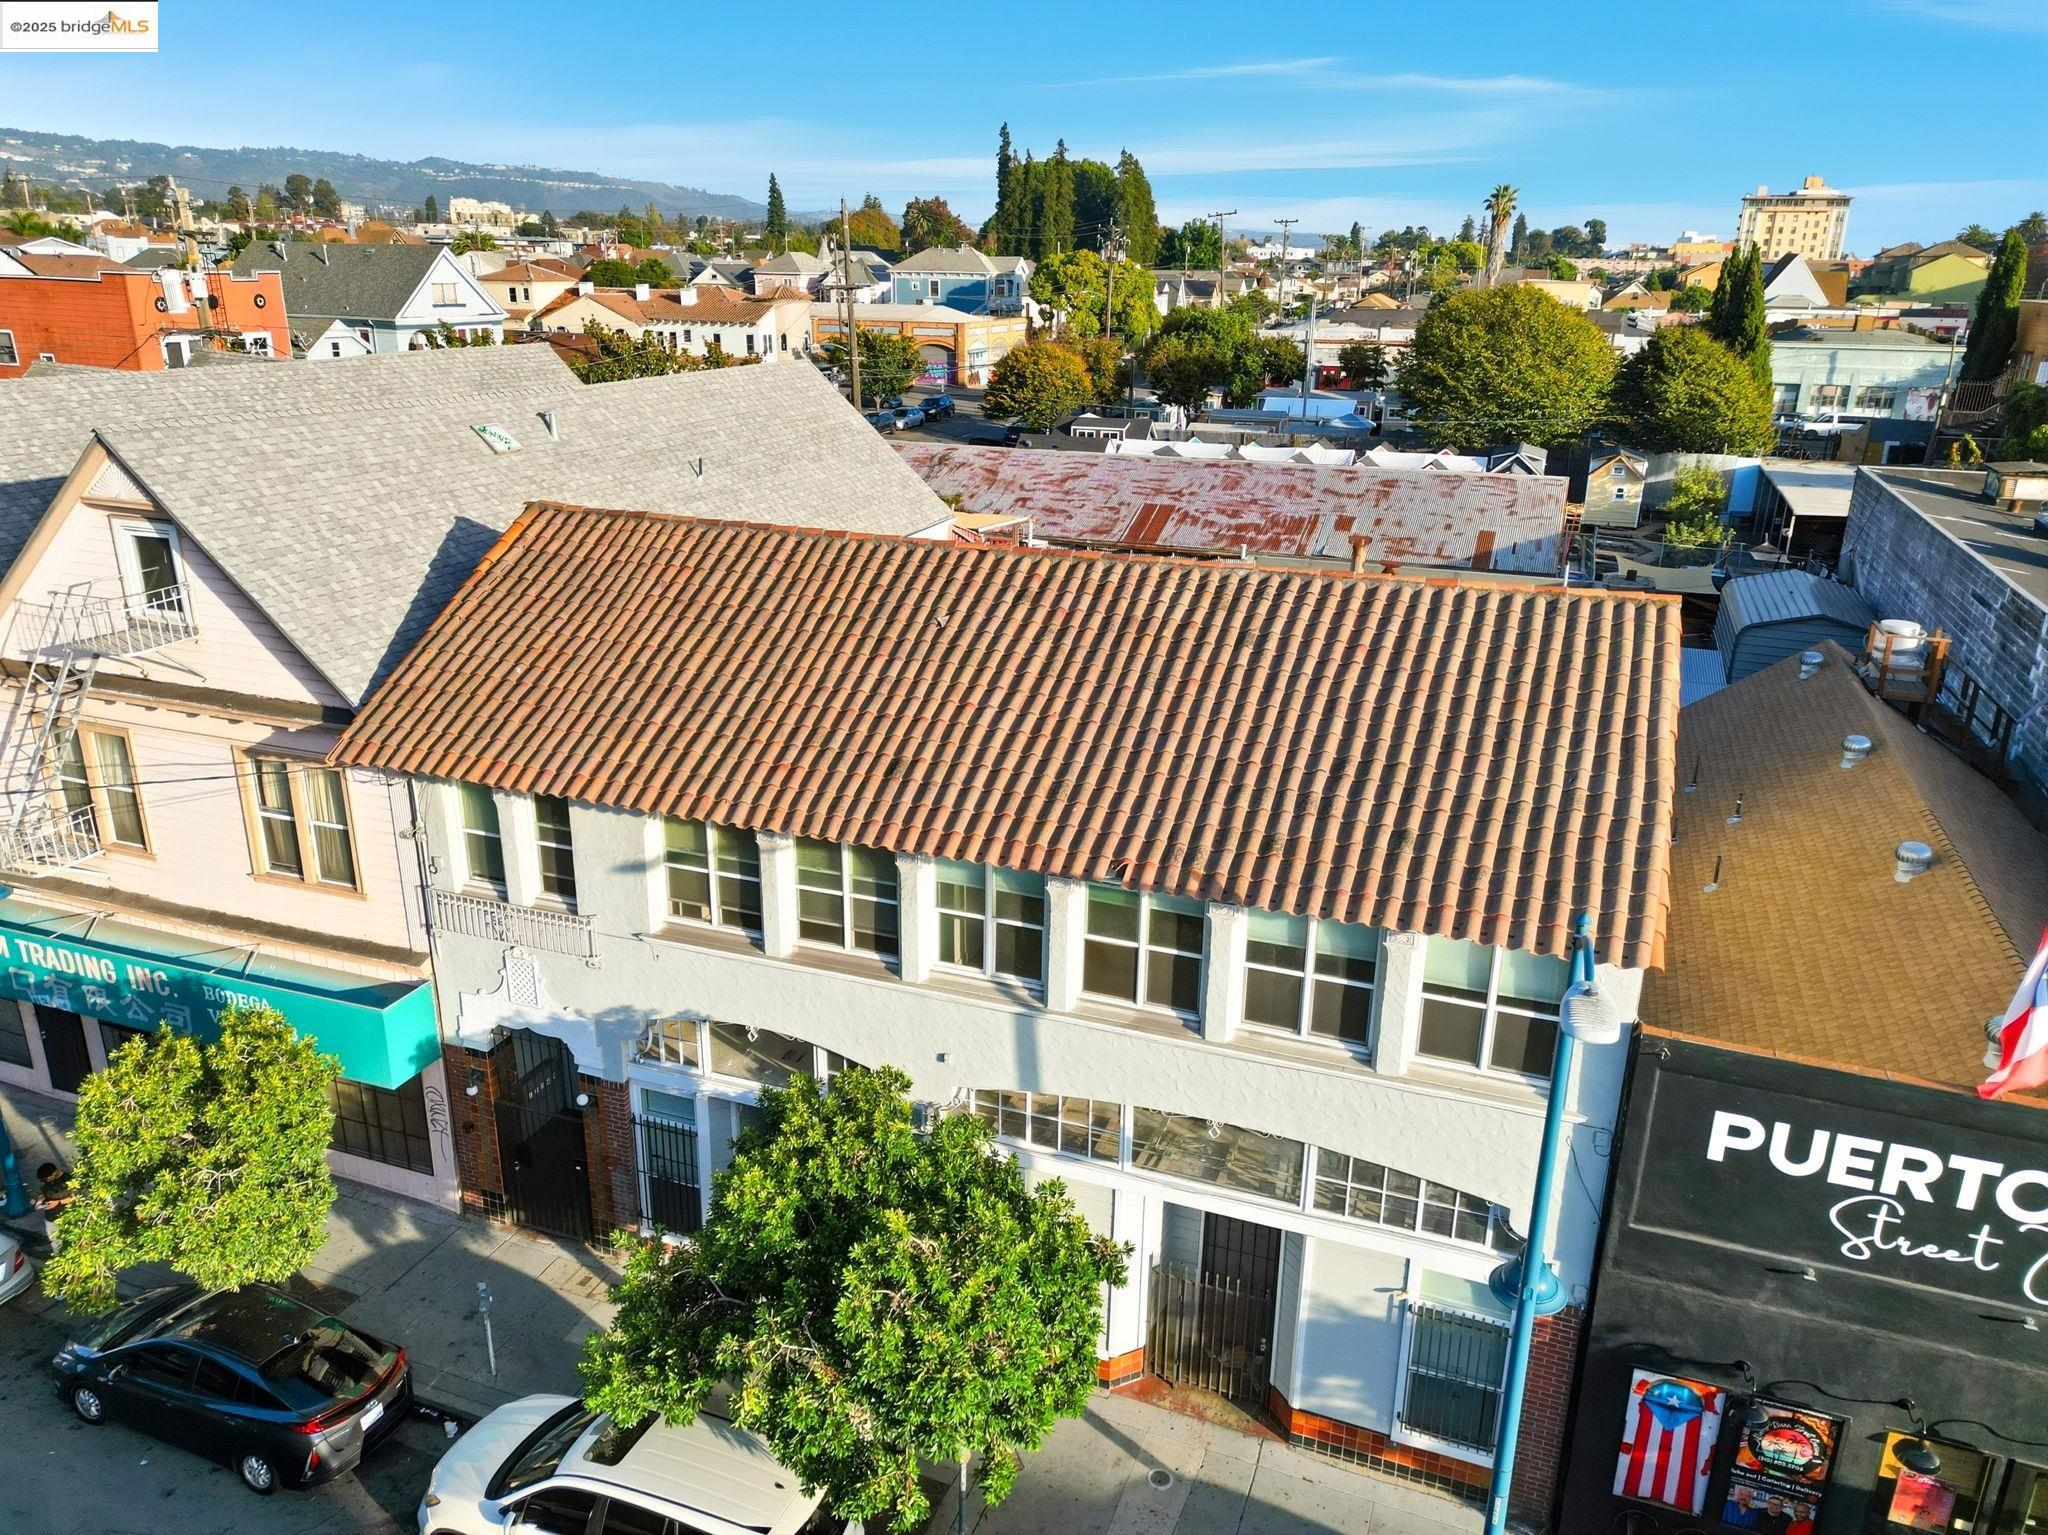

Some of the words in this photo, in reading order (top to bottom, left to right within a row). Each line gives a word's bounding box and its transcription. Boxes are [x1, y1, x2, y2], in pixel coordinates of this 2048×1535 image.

[14, 938, 117, 984] TRADING
[126, 964, 179, 998] INC.
[202, 985, 270, 1011] BODEGA
[1706, 1110, 2048, 1225] PUERTO
[1829, 1195, 2004, 1271] Street
[1761, 1476, 1791, 1489] Catering
[1795, 1485, 1823, 1497] Delivery
